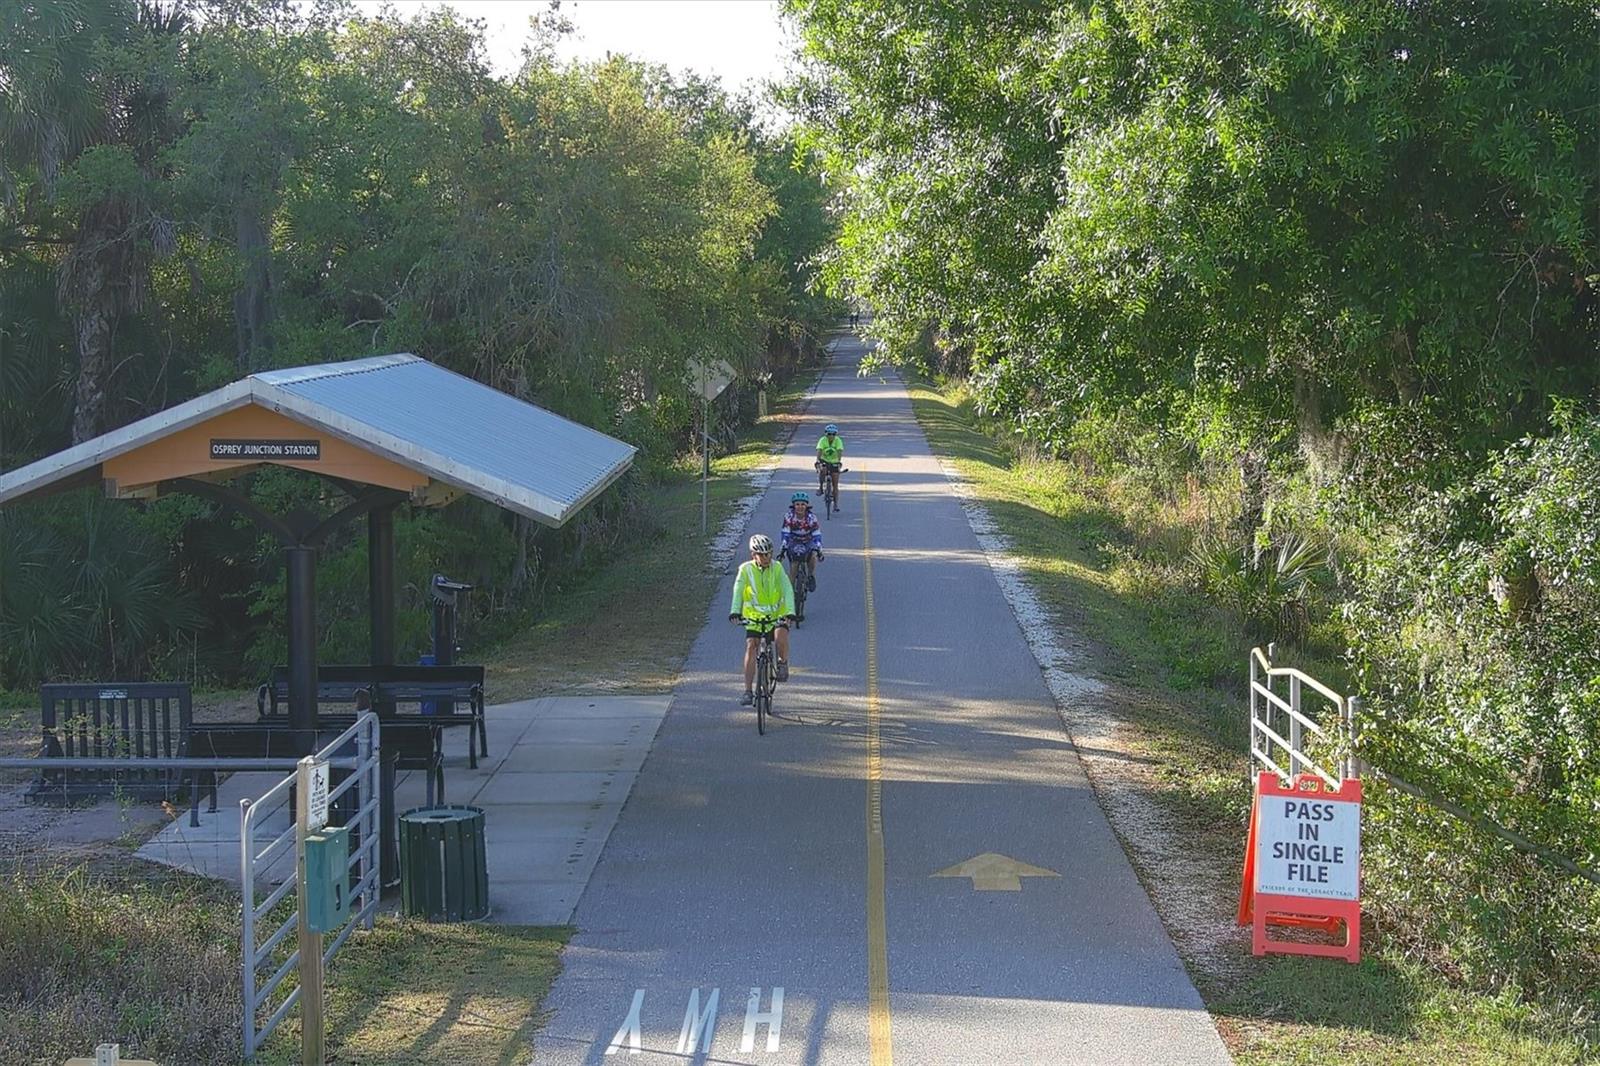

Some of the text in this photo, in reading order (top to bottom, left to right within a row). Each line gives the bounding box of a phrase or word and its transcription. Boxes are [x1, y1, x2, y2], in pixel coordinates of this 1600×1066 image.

[212, 445, 318, 455] OSPREY JUNCTION STATION
[1285, 801, 1334, 821] PASS
[1298, 823, 1319, 841] IN
[1273, 842, 1344, 864] SINGLE
[1288, 863, 1328, 883] FILE
